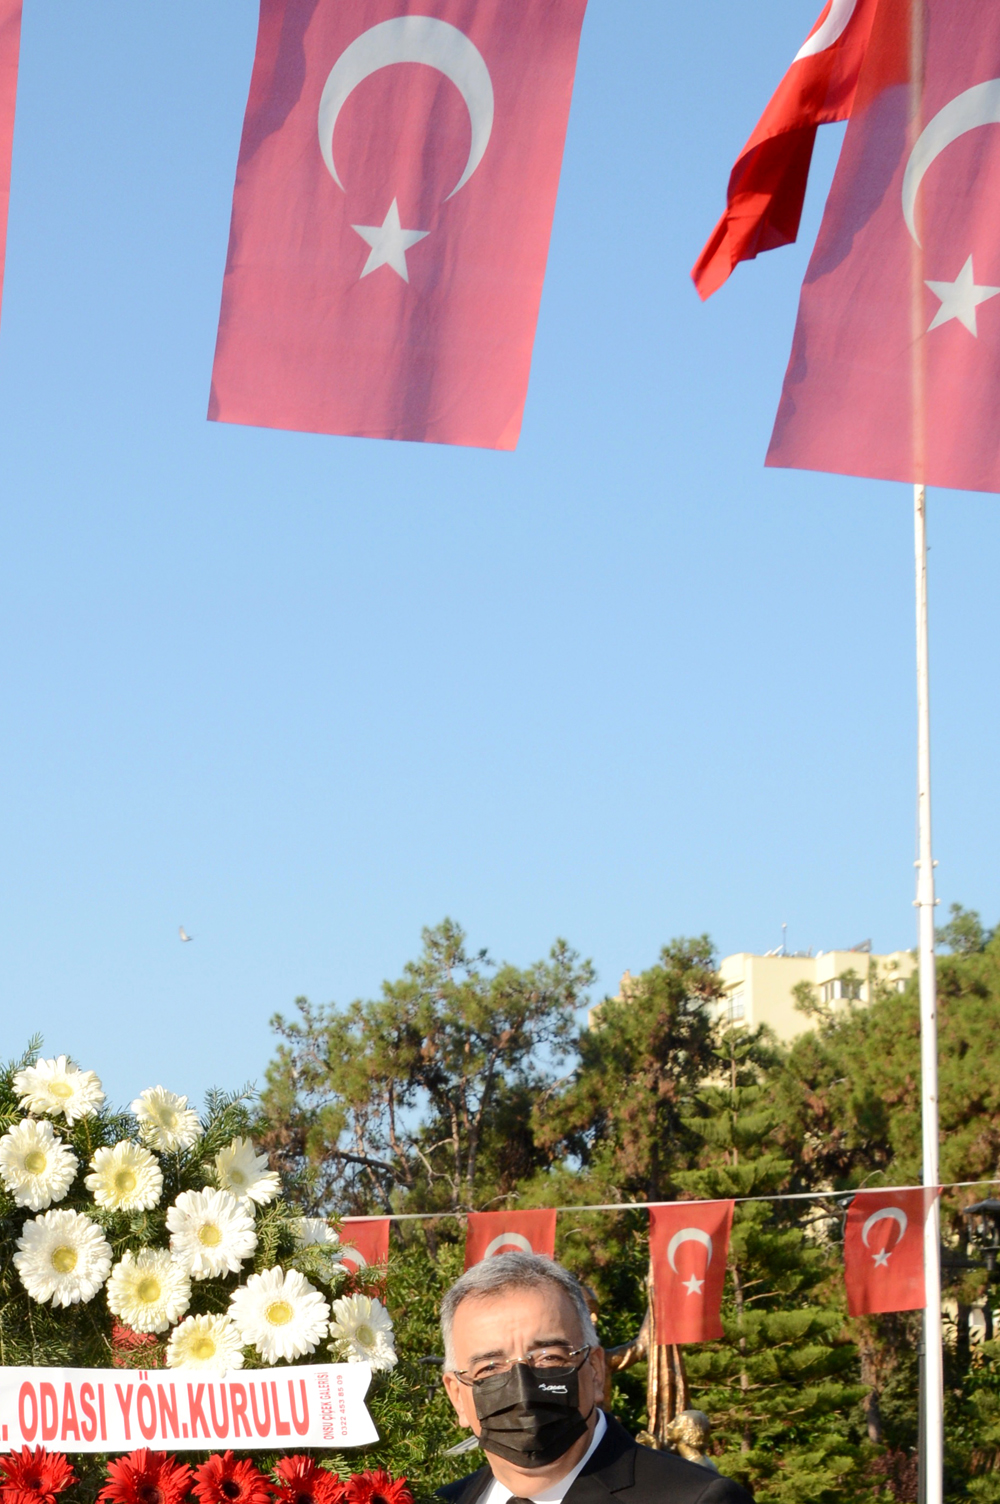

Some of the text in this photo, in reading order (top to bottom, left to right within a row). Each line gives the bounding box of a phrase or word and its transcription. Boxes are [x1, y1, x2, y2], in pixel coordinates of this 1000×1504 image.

[18, 1380, 108, 1442] ODASI
[313, 1371, 331, 1400] GALERİSİ
[336, 1374, 348, 1436] 0322 453 85 09
